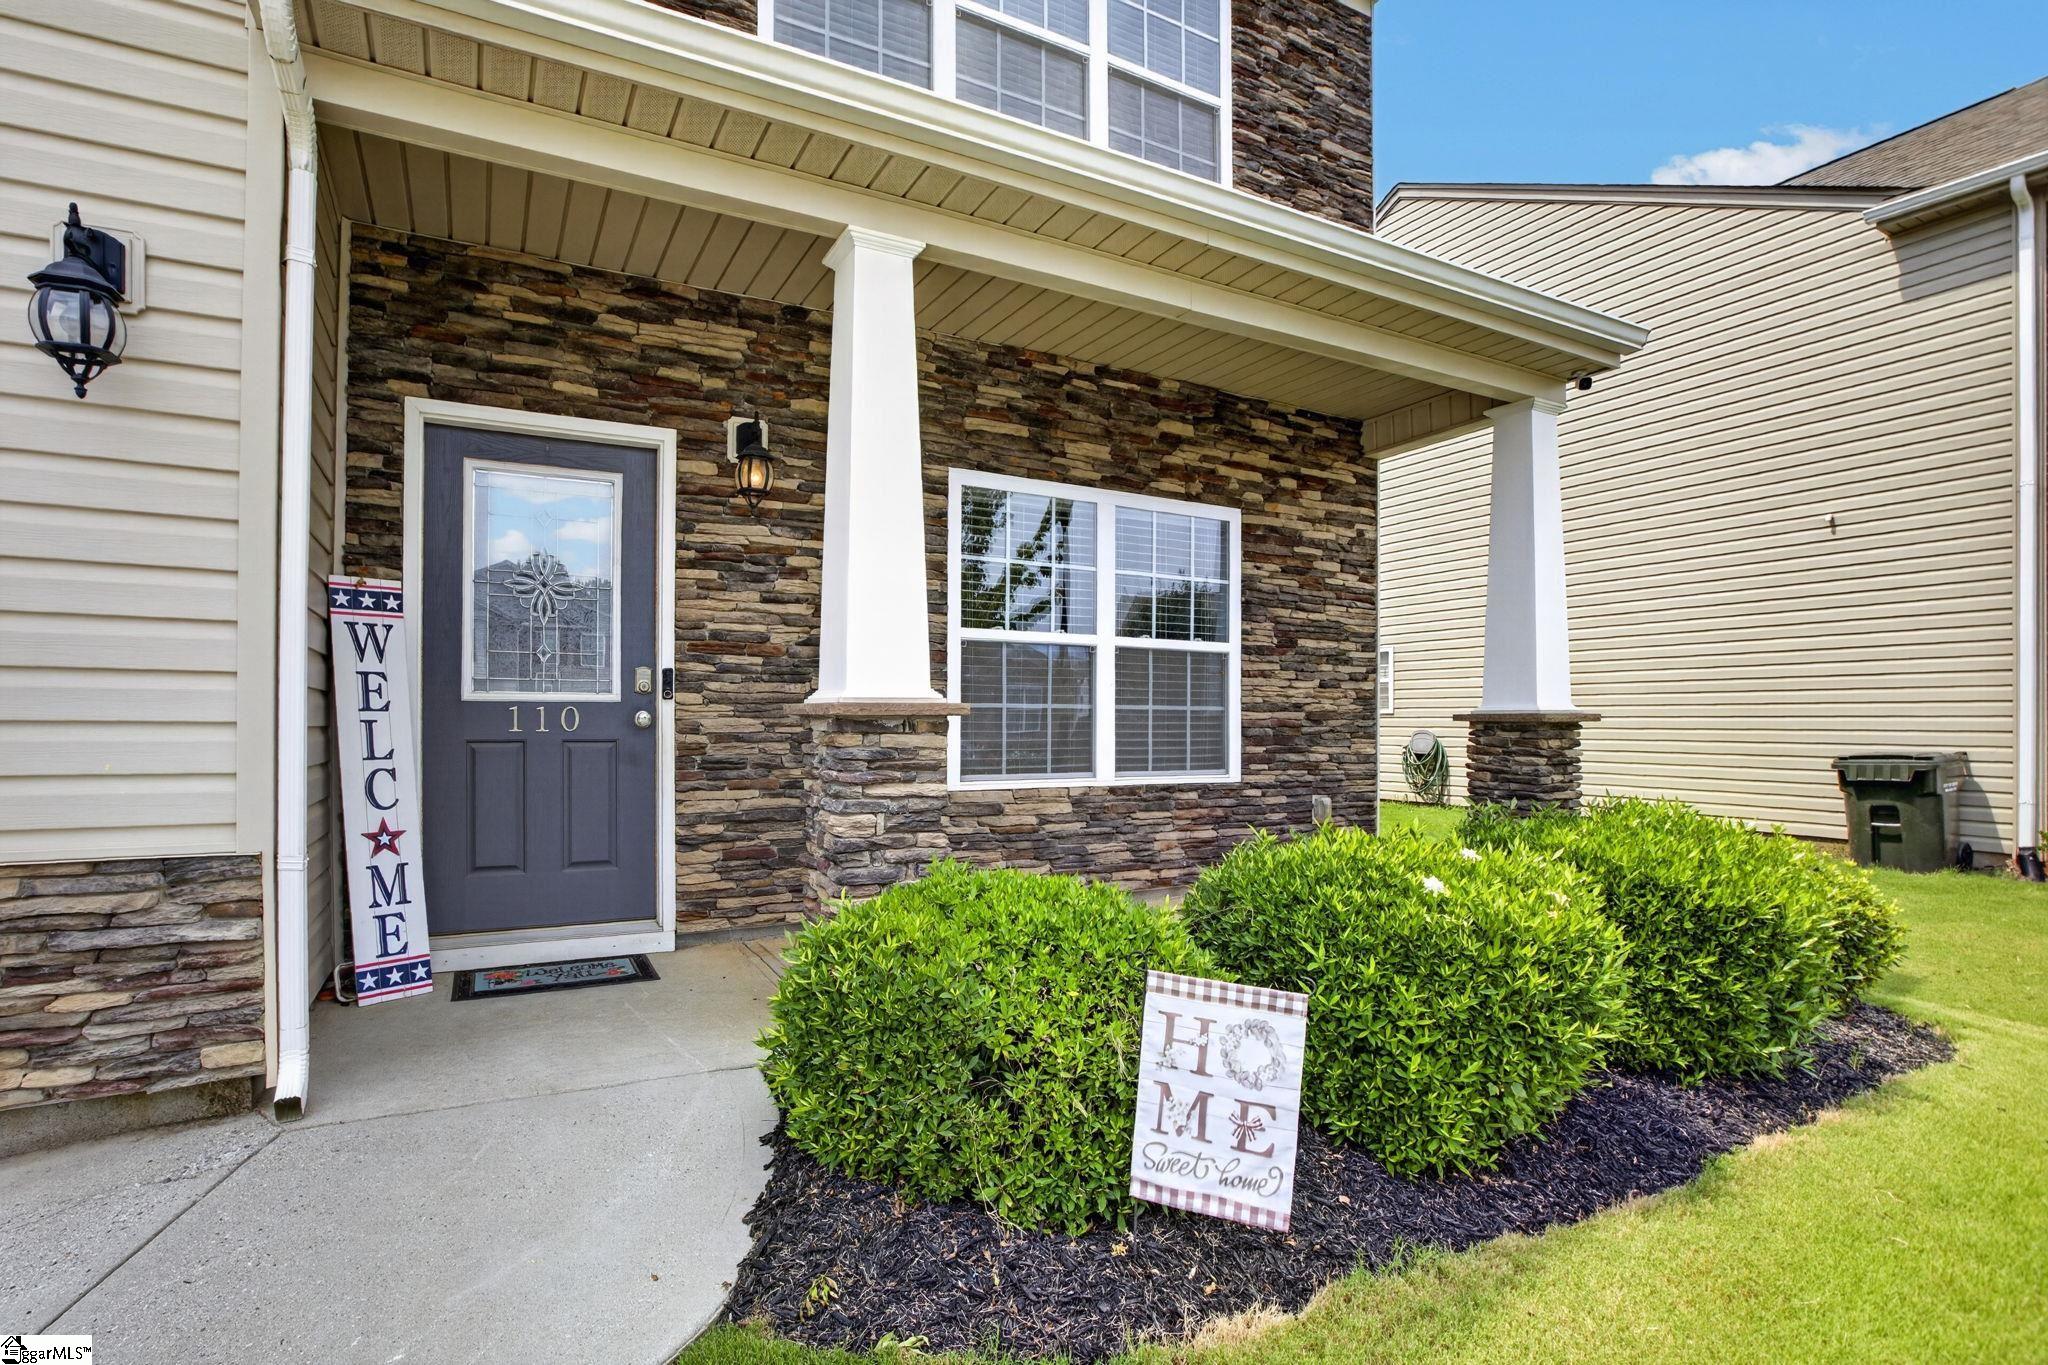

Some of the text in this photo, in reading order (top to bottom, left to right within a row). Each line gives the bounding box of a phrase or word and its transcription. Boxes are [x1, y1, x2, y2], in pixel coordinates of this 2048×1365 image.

[508, 706, 580, 732] 110
[344, 621, 412, 958] WELCME
[1142, 1141, 1284, 1198] Sweet home
